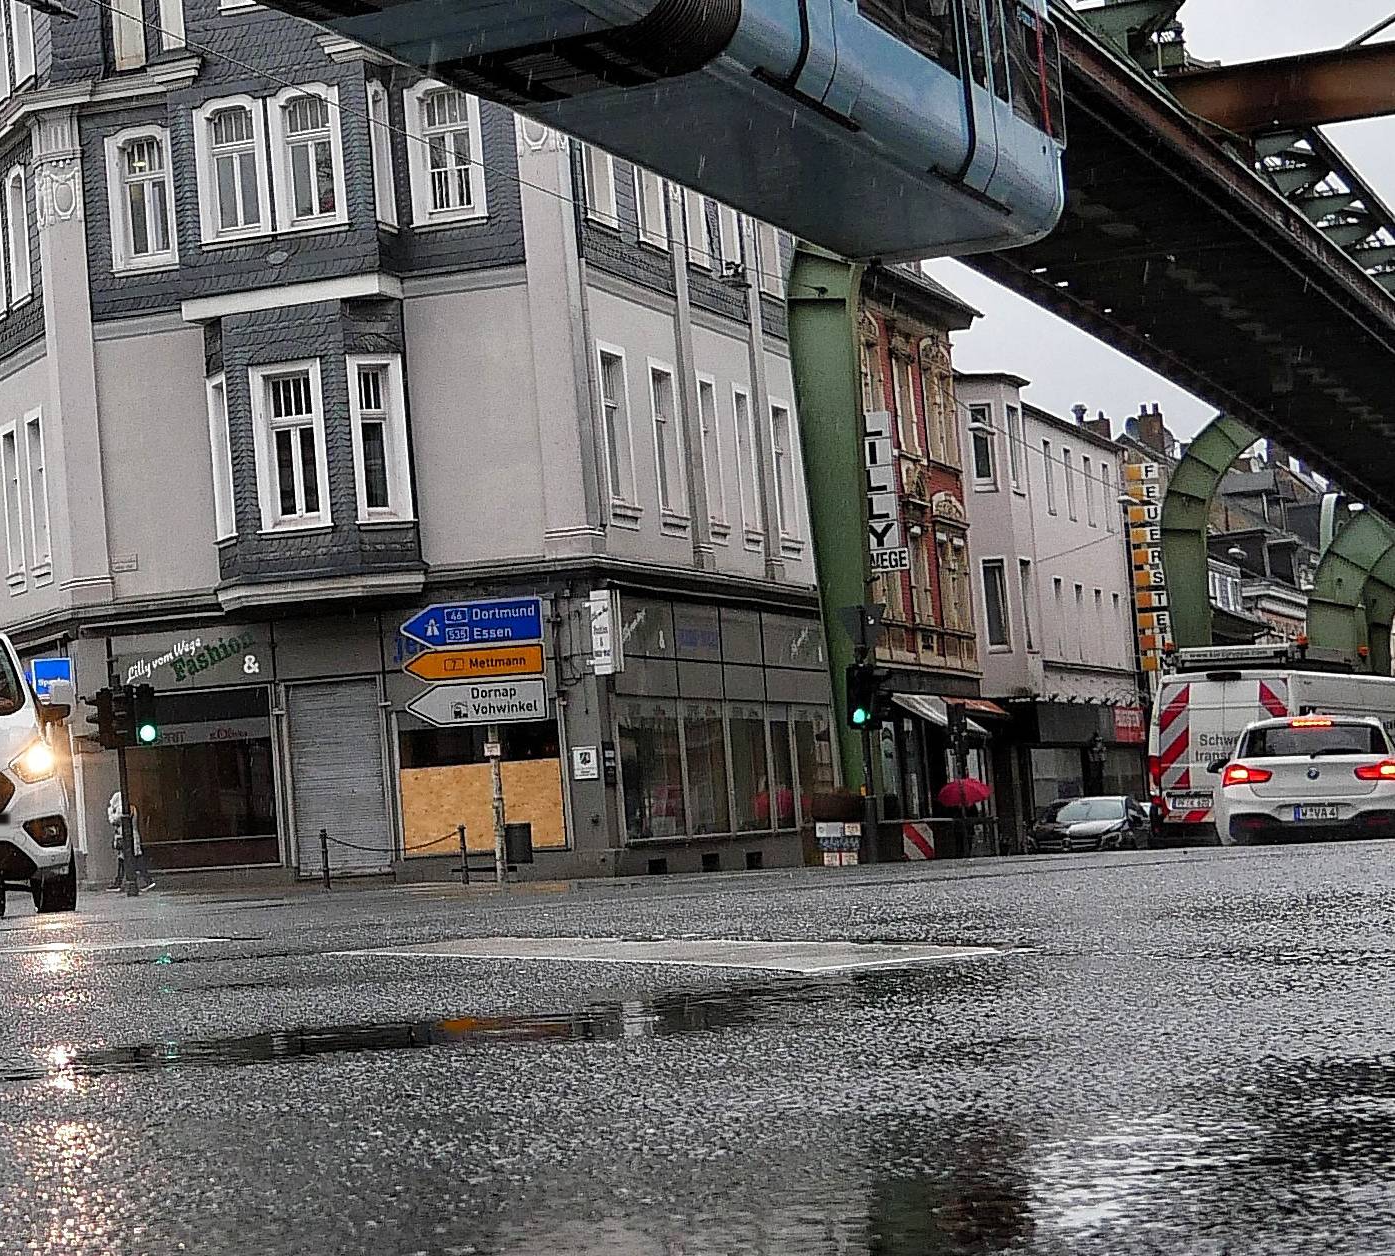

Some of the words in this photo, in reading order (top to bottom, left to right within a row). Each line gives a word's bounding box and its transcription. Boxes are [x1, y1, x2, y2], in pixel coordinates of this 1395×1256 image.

[450, 611, 462, 621] 46
[472, 605, 535, 621] Dortmund
[448, 629, 467, 639] 535
[473, 627, 512, 639] Essen
[172, 631, 255, 682] Fashion
[469, 656, 526, 670] Mettmann
[126, 657, 151, 684] Lilly
[152, 652, 174, 668] vom
[243, 655, 260, 674] &
[471, 687, 517, 699] Dornap
[472, 700, 538, 715] Vohwinkel
